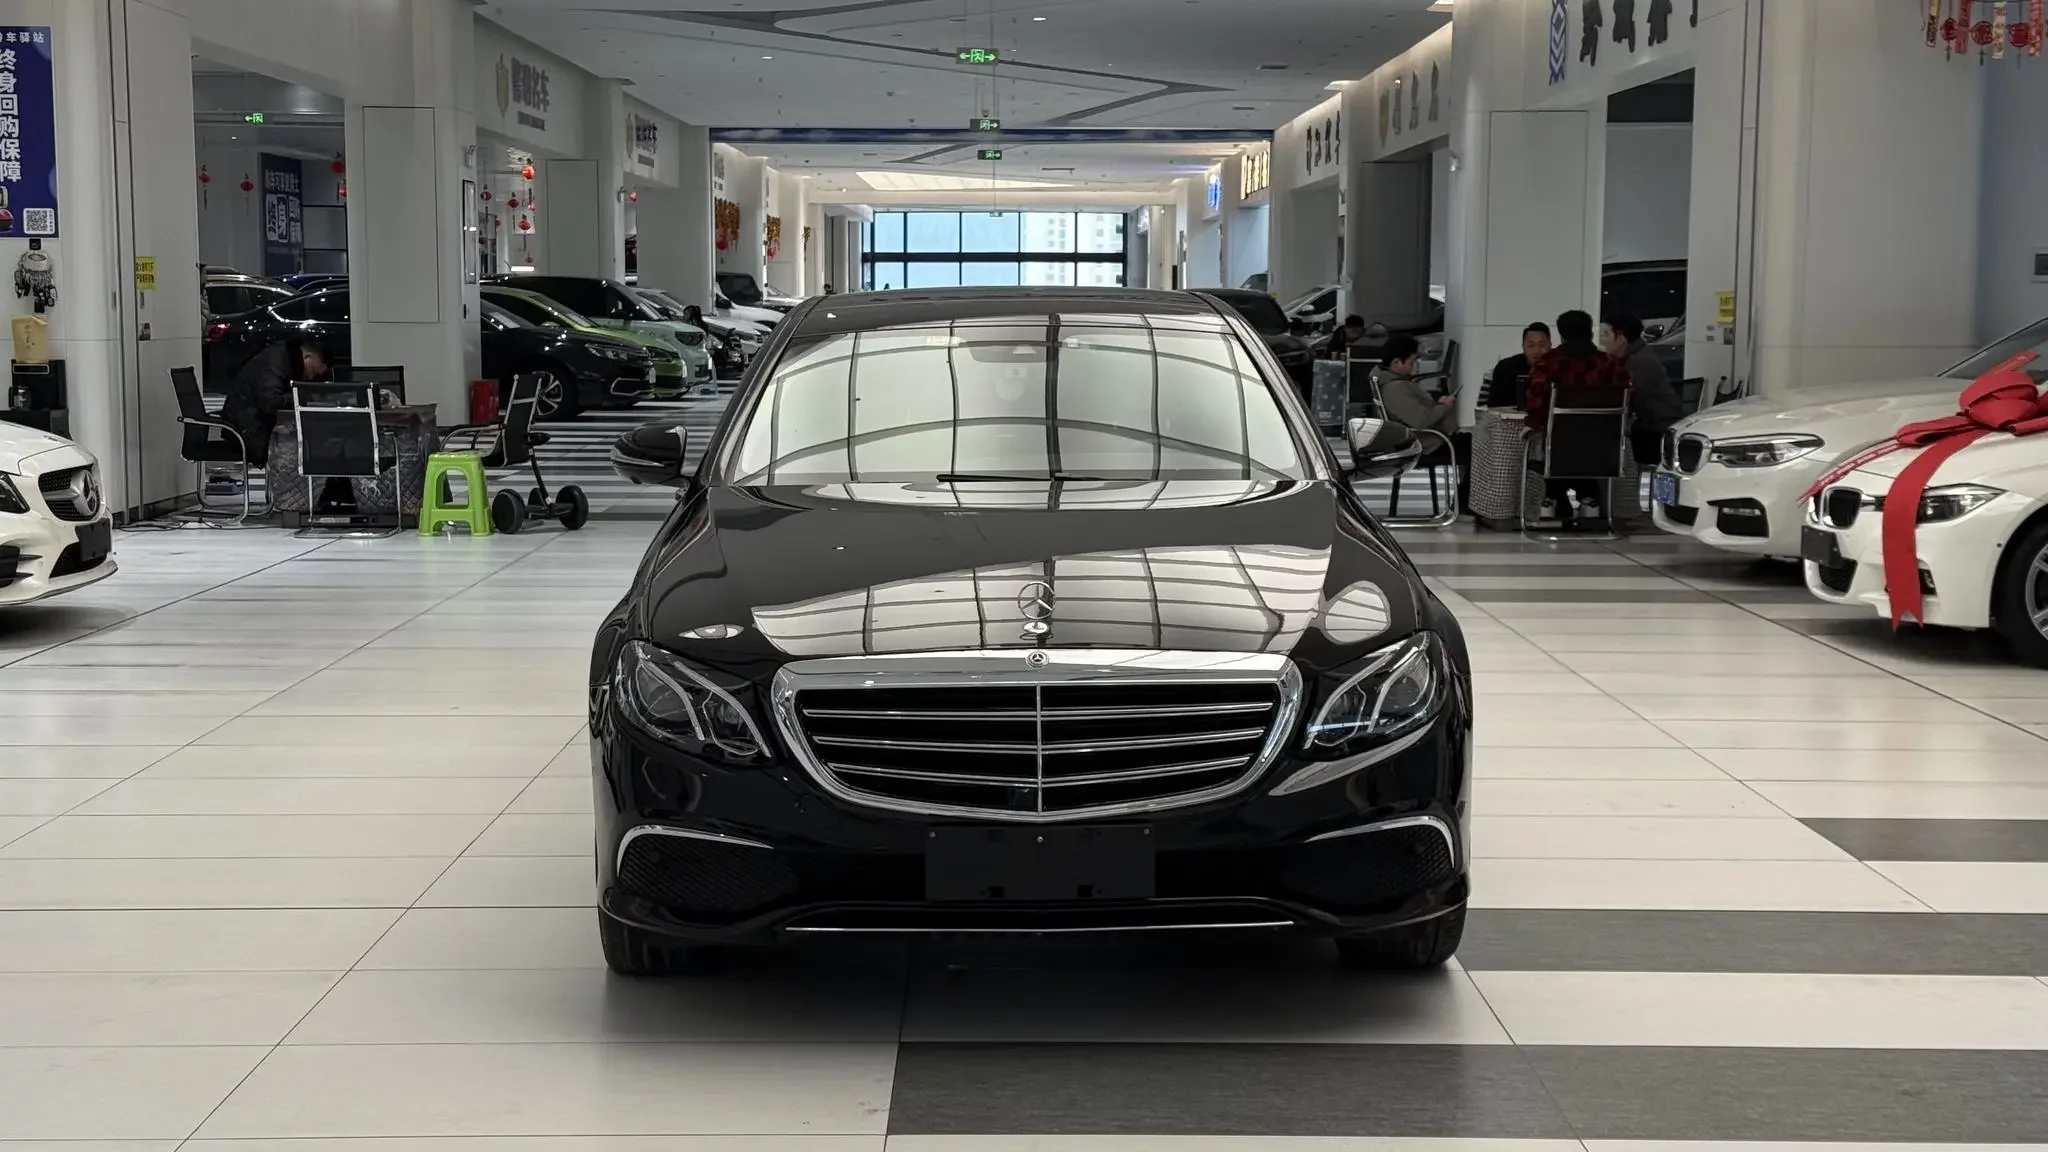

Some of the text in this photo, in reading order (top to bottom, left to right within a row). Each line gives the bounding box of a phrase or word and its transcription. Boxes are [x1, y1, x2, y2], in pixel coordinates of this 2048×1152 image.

[0, 31, 44, 43] 车驿站
[0, 48, 21, 182] 终身回购保障
